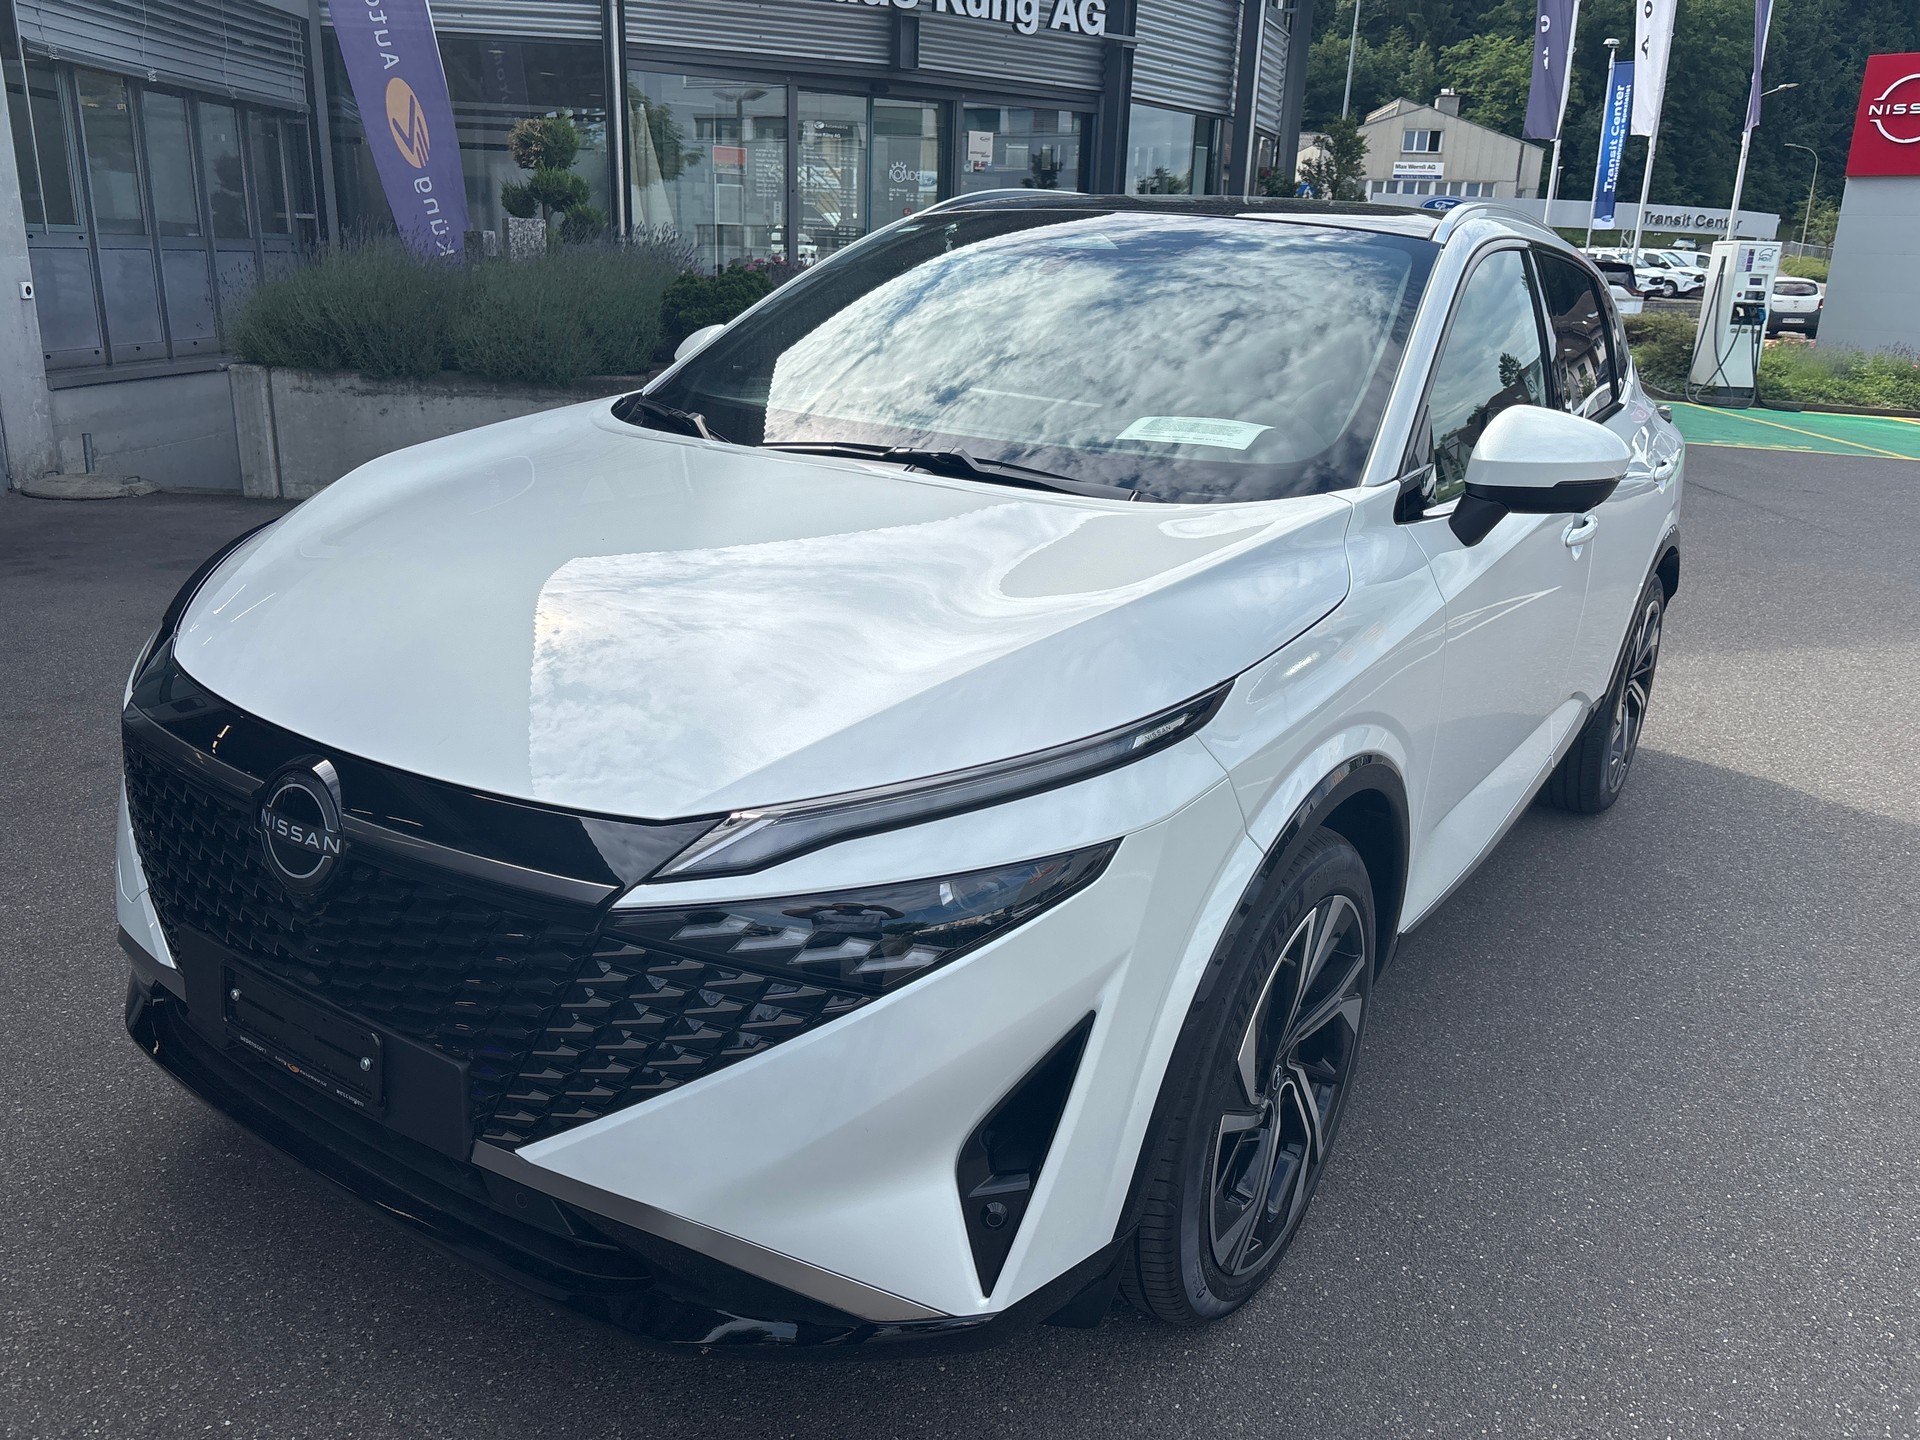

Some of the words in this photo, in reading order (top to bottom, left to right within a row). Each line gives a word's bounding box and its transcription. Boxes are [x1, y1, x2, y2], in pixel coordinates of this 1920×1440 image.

[1050, 0, 1106, 36] AG
[1610, 84, 1625, 136] Center
[1603, 138, 1619, 193] Transit
[1643, 211, 1691, 227] Transit
[1695, 214, 1743, 230] Centr
[261, 808, 341, 854] NISSAN
